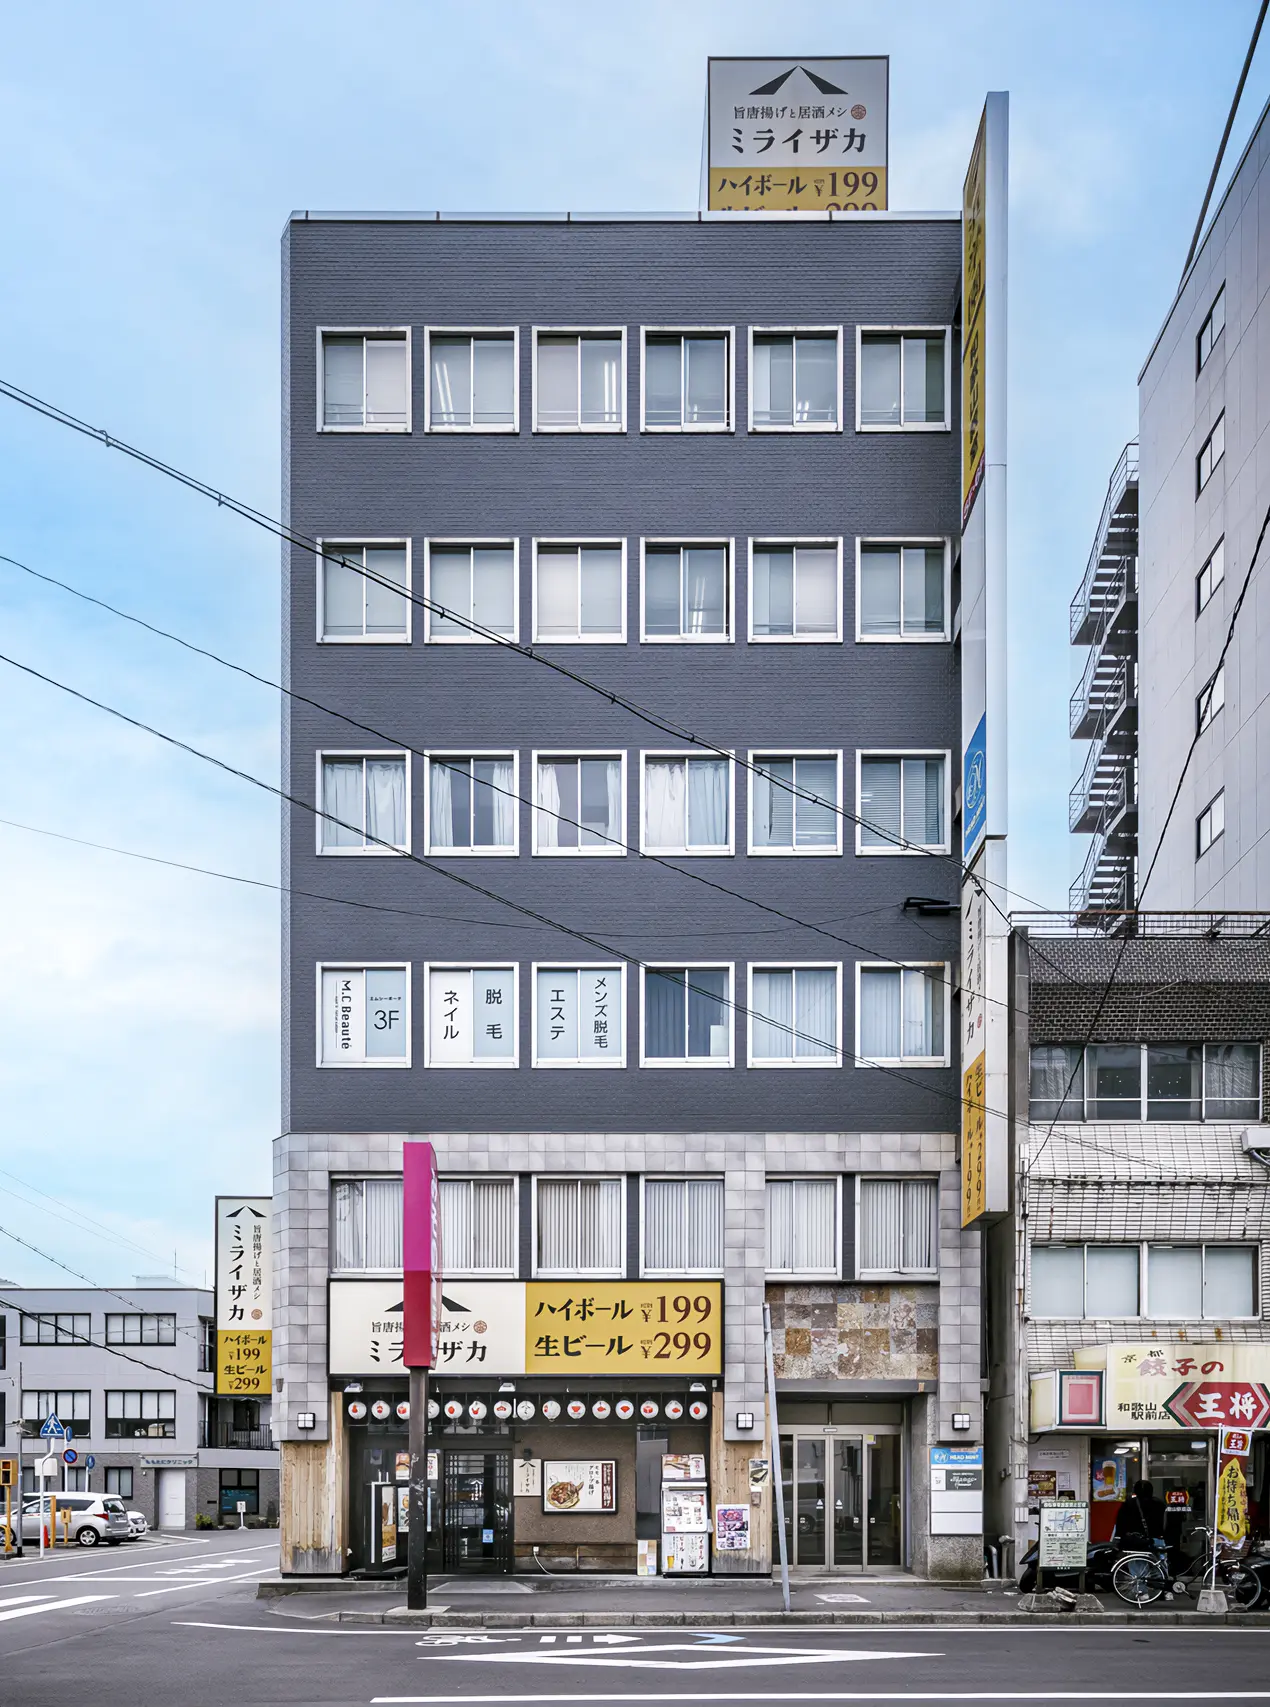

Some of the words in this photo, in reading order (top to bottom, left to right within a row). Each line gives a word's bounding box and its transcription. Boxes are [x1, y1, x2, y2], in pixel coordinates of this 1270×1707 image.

[734, 105, 848, 120] 旨唐揚げと居酒メシ
[732, 127, 867, 154] ミライザカ
[717, 173, 808, 197] ハイボール
[341, 980, 352, 1003] M.C
[965, 920, 976, 1045] ミライザカ
[373, 1009, 400, 1031] 3F
[443, 990, 460, 1040] ネイル
[485, 989, 503, 1040] 脱毛
[550, 989, 566, 1041] エステ
[593, 977, 608, 1049] メンズ脱毛
[341, 1006, 352, 1050] Beauté
[228, 1223, 248, 1322] ミライザカ
[252, 1225, 262, 1301] 旨唐揚げと居酒メシ
[534, 1297, 634, 1322] ハイボール
[640, 1295, 712, 1324] ¥199
[223, 1335, 268, 1346] ハイボール
[369, 1340, 488, 1363] ミラザカ
[534, 1335, 634, 1357] 生ビール
[640, 1332, 712, 1361] ¥299
[223, 1364, 268, 1376] 生ビール
[1135, 1357, 1225, 1377] 餃子の
[1117, 1402, 1157, 1412] 和歌山
[1131, 1410, 1171, 1421] 駅前店
[1193, 1391, 1258, 1421] 王将
[1226, 1465, 1240, 1536] お持ち帰り
